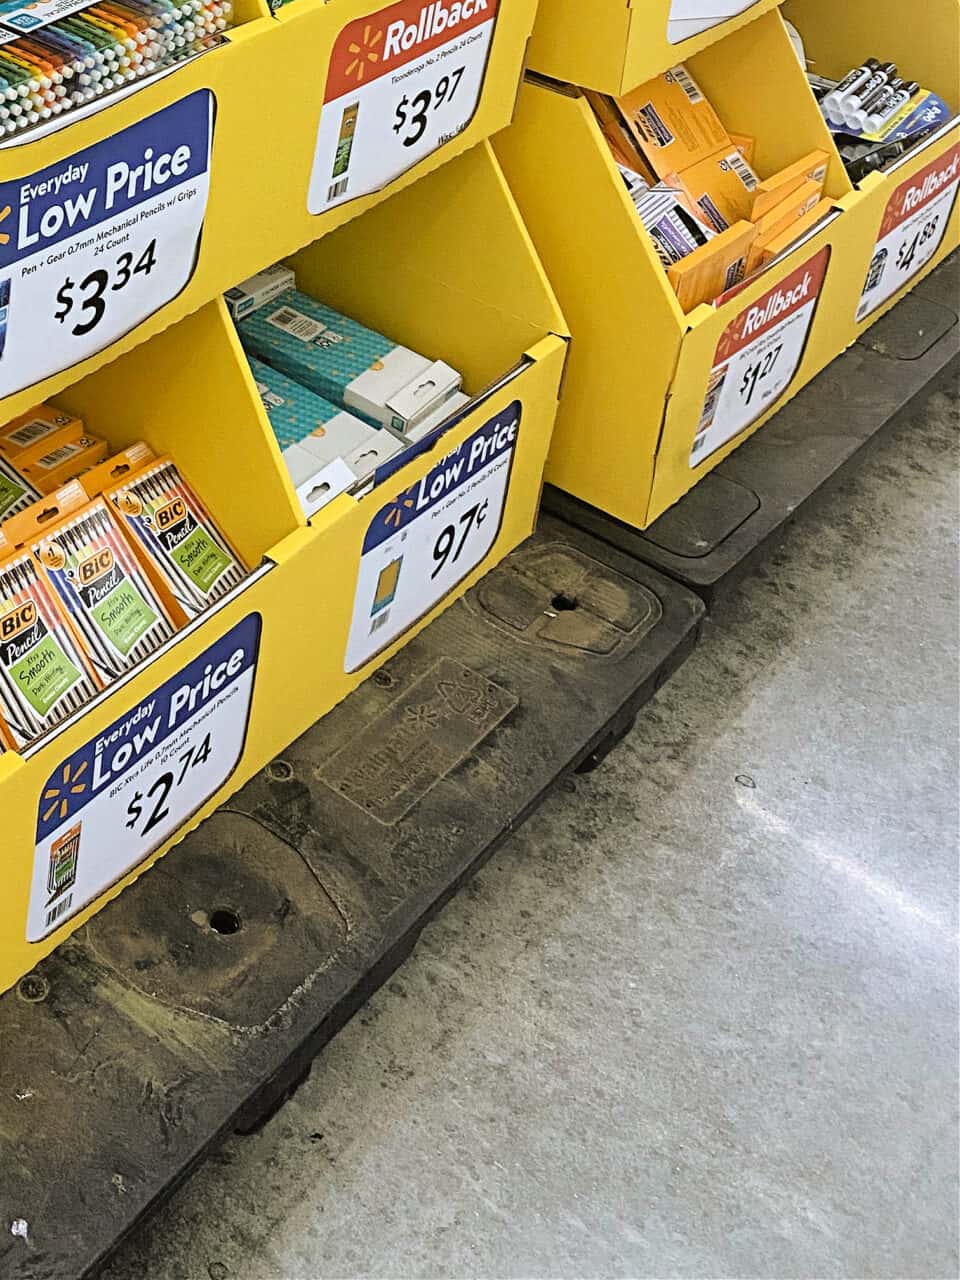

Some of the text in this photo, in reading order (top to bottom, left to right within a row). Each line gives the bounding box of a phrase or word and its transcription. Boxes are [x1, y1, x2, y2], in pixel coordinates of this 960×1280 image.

[391, 62, 425, 85] Ticonderoga
[17, 144, 191, 250] Low Price
[20, 162, 88, 204] Everyday
[901, 153, 960, 216] Rollback
[22, 187, 197, 278] Pen Gear 0.7mm Mechanical Pencils Grips
[94, 233, 130, 257] 24 Count
[741, 272, 811, 339] Rollback
[416, 458, 464, 511] Low
[468, 419, 517, 472] Price
[166, 519, 194, 548] Pencil
[88, 569, 120, 605] Pencil
[101, 593, 134, 626] Smooth
[7, 624, 41, 662] Pencil
[19, 649, 56, 685] Smooth
[217, 685, 239, 710] Pencils
[91, 648, 244, 791] Low Price
[94, 699, 157, 753] Everyday
